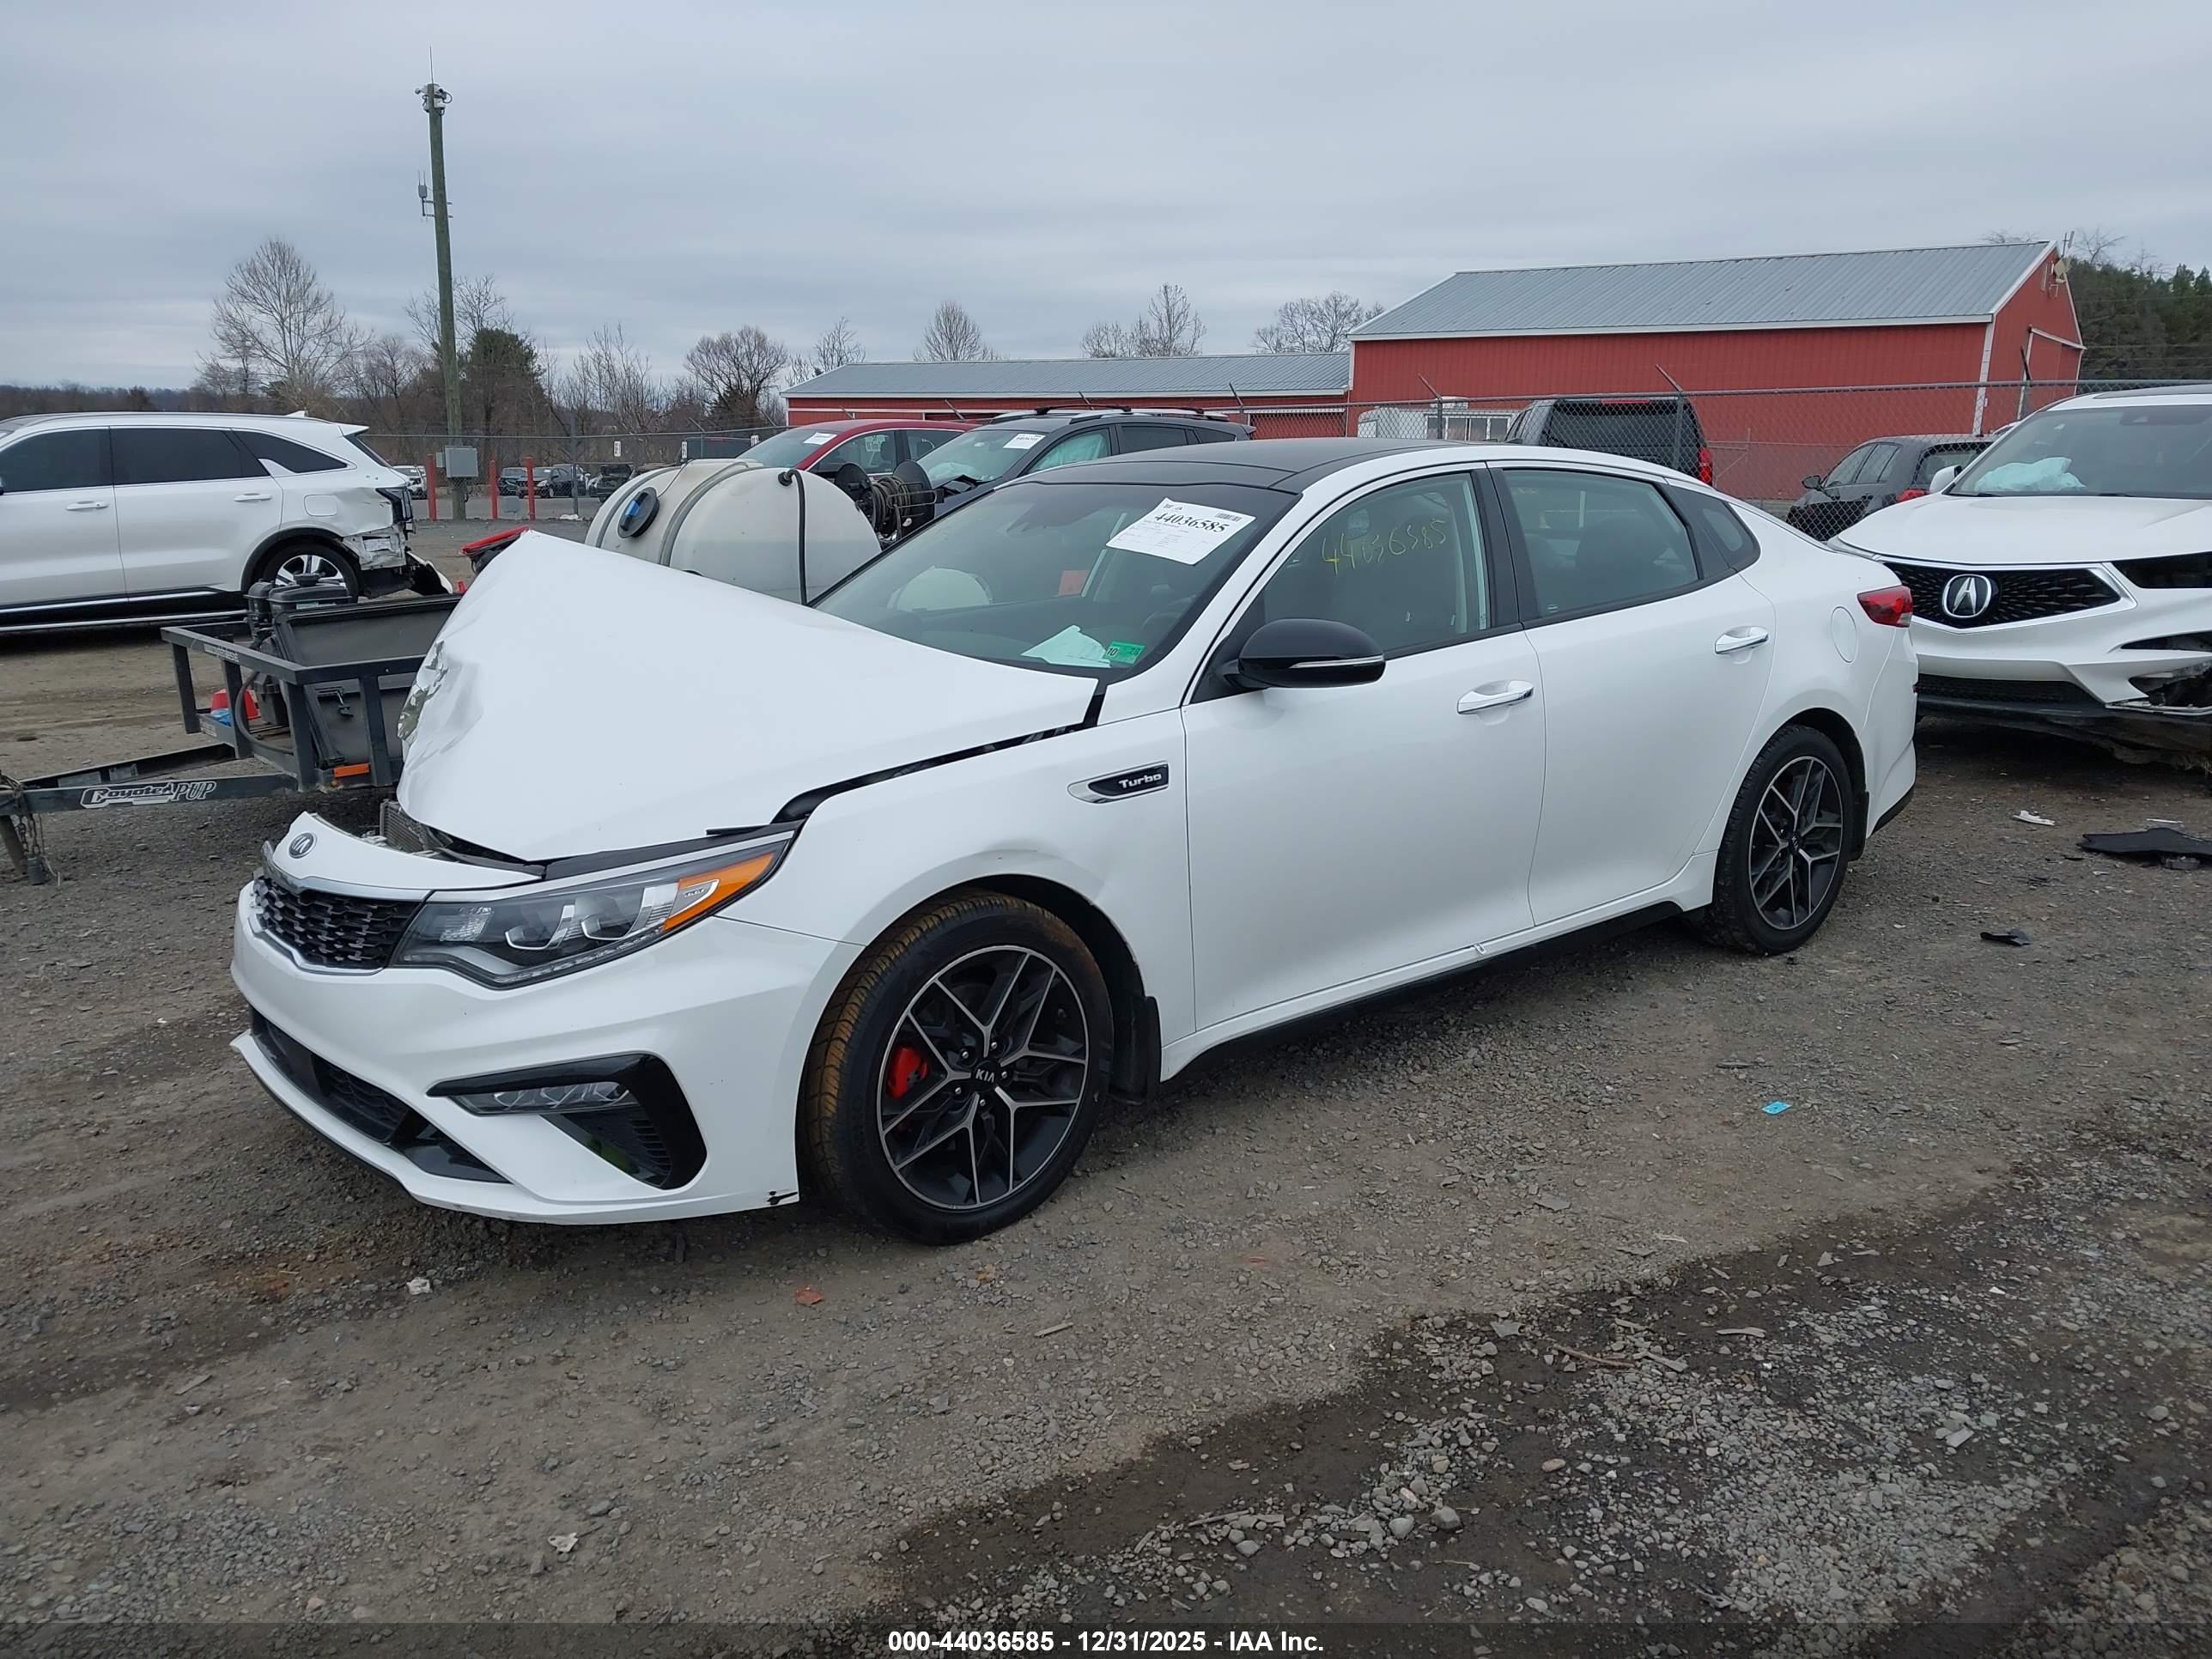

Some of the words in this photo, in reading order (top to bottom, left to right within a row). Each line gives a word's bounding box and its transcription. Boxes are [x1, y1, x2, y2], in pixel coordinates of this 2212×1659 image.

[1154, 512, 1231, 533] 44036585
[1106, 647, 1119, 657] 10
[1118, 774, 1162, 789] Turbo
[81, 781, 164, 809] Coyote
[171, 780, 216, 802] PUP
[975, 1068, 995, 1083] KIA
